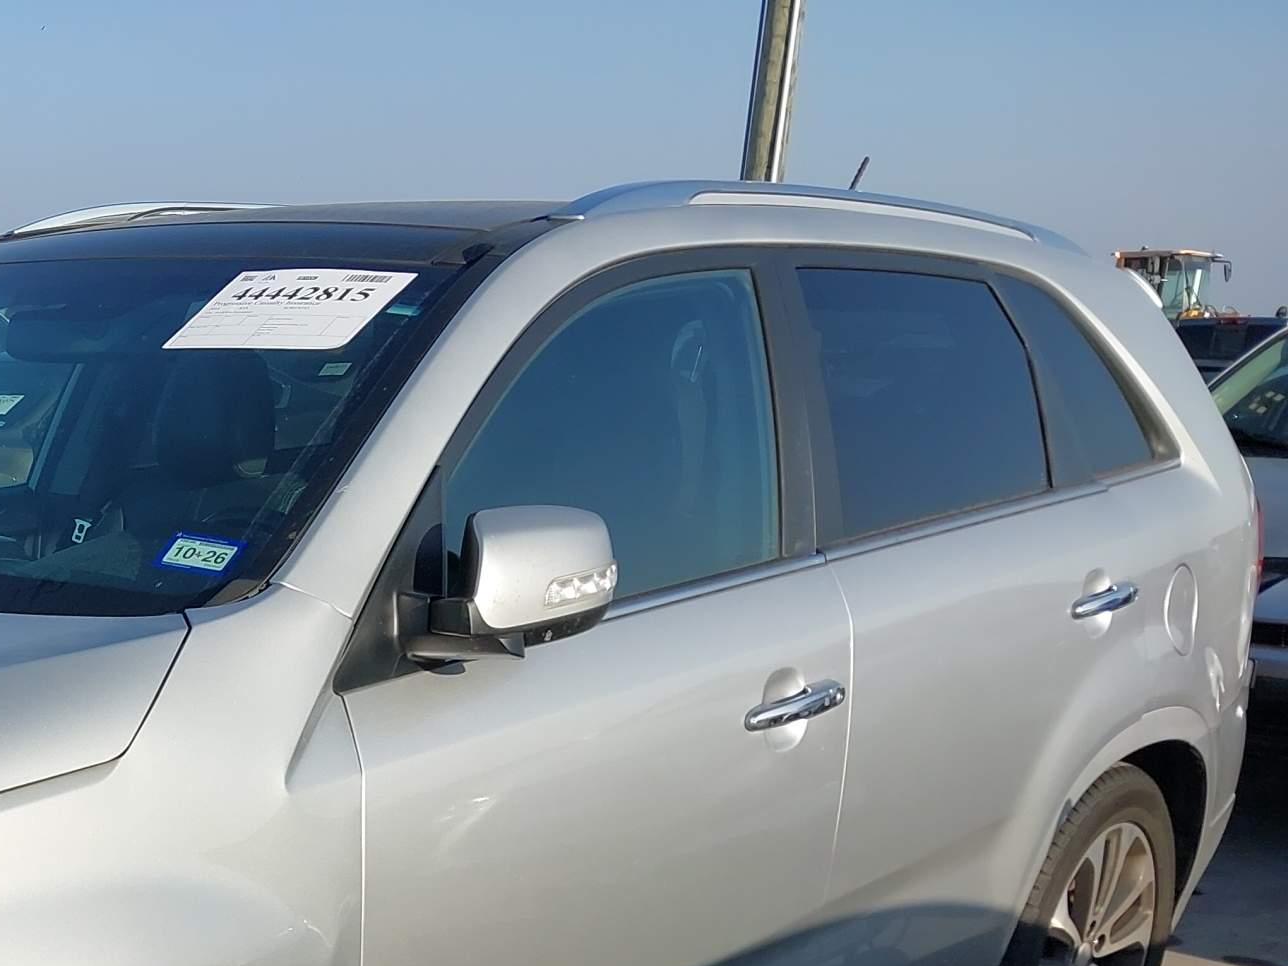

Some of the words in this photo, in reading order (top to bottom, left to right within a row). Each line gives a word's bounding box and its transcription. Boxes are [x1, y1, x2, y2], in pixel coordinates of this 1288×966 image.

[232, 286, 376, 302] 44442815
[174, 545, 196, 559] 10
[201, 550, 228, 564] 26
